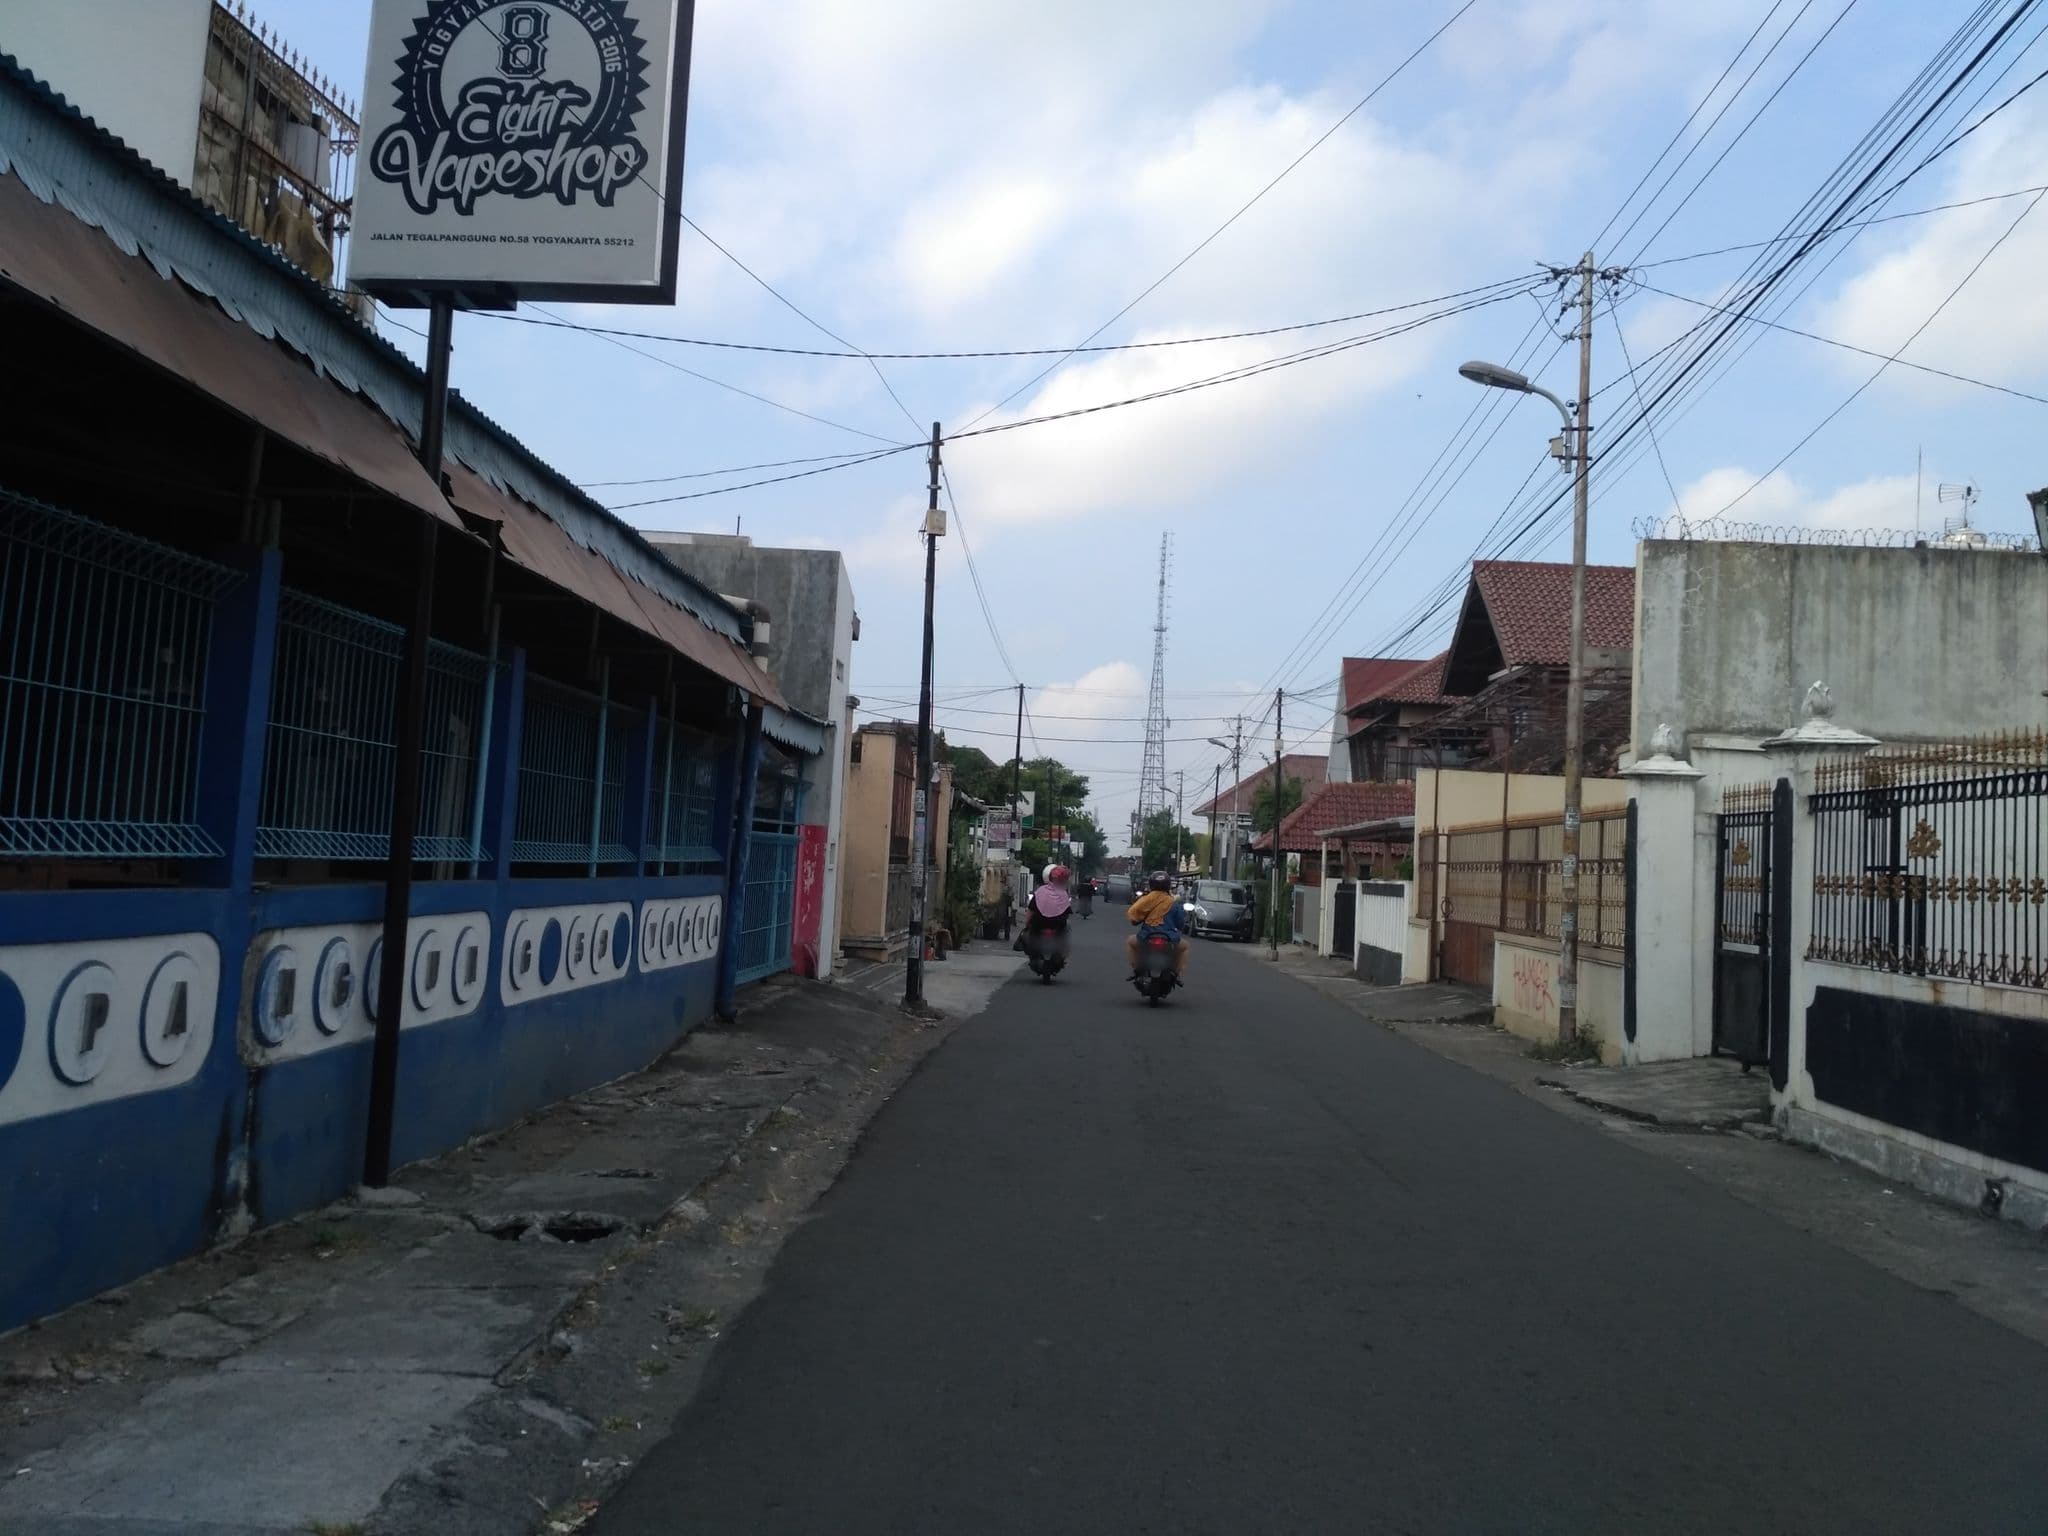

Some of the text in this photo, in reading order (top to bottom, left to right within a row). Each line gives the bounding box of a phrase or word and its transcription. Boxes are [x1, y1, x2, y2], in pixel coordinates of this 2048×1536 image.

[497, 2, 550, 78] 8
[599, 35, 622, 72] 2016
[456, 82, 590, 144] Eight
[377, 129, 641, 208] Vapeshop
[370, 233, 635, 247] JALAN TEGALPANGGUNG NO.58 YOGYAKARTA 55212
